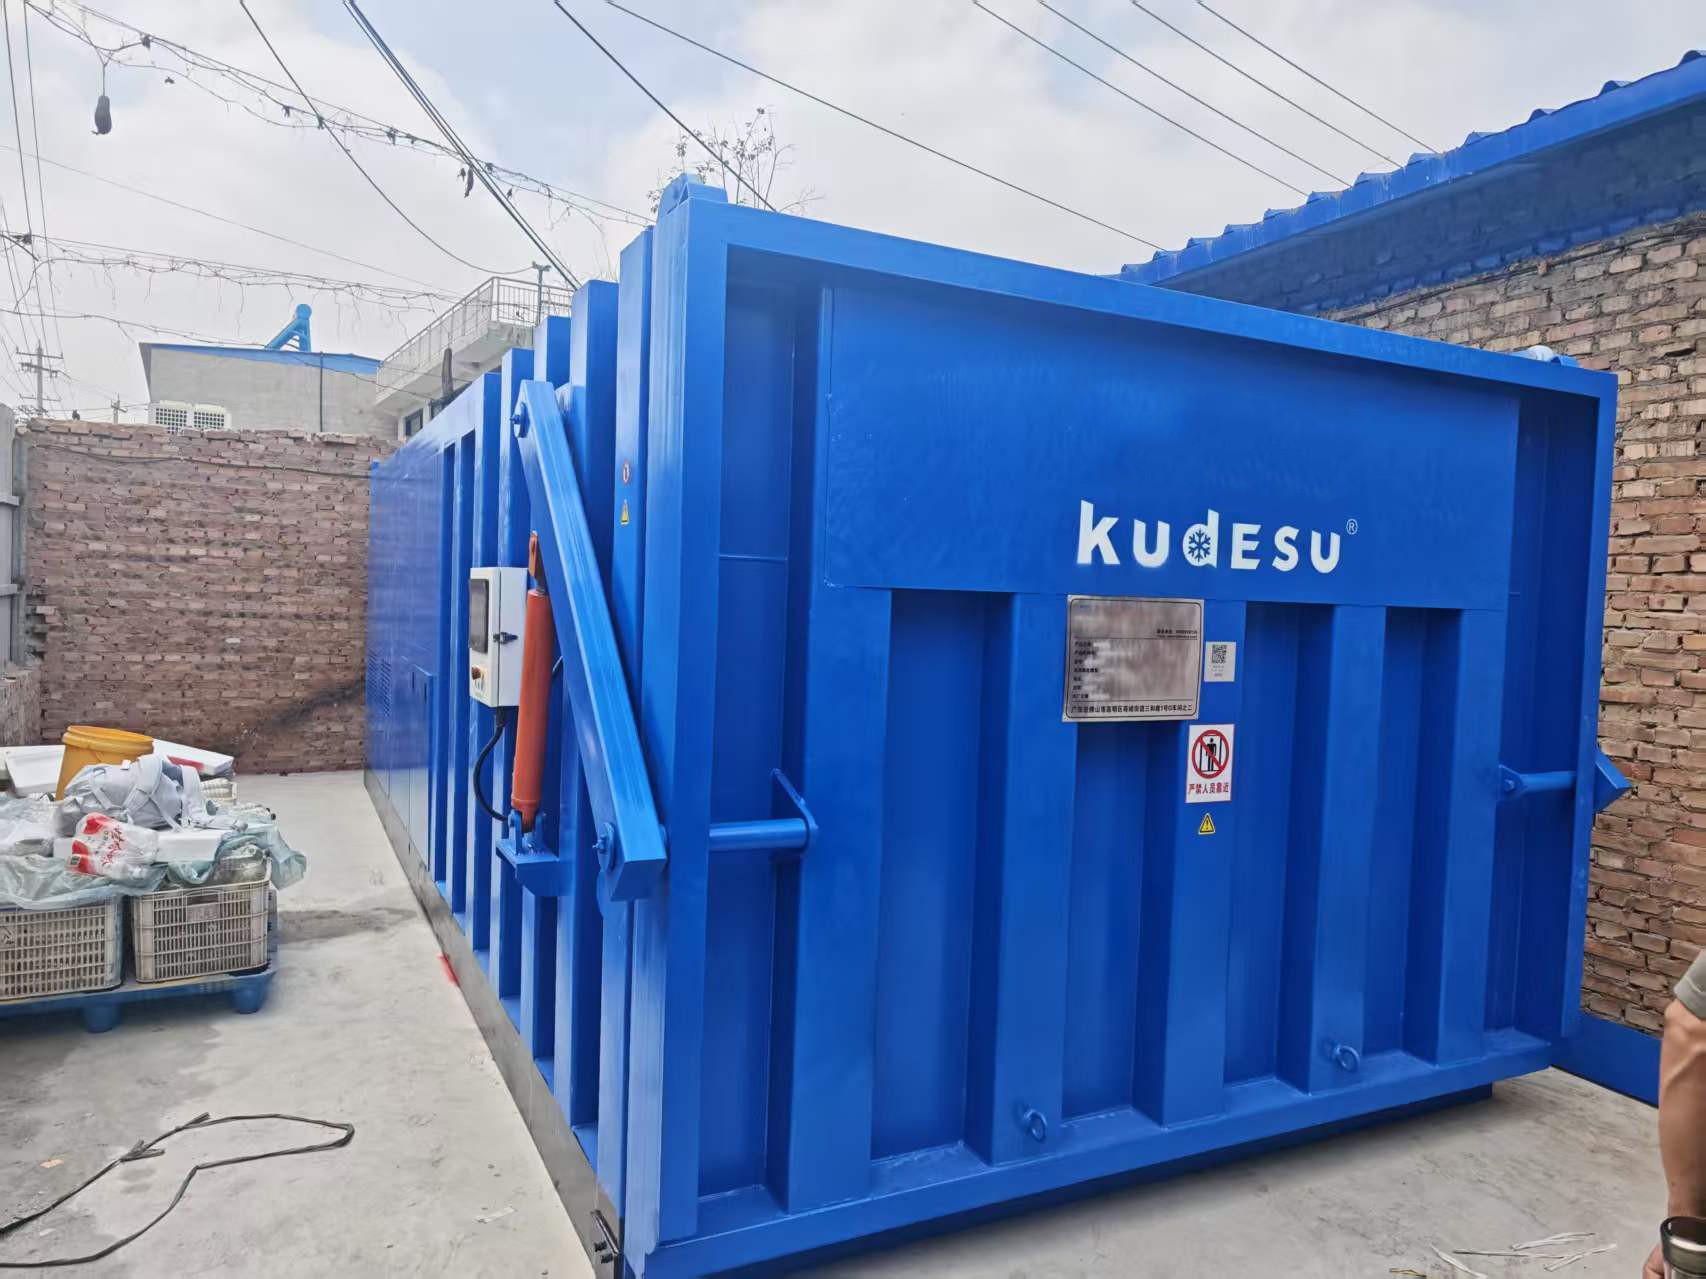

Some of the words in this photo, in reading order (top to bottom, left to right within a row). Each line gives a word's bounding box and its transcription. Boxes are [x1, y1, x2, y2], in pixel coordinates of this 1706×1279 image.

[1188, 782, 1229, 795] 严禁人员靠近
